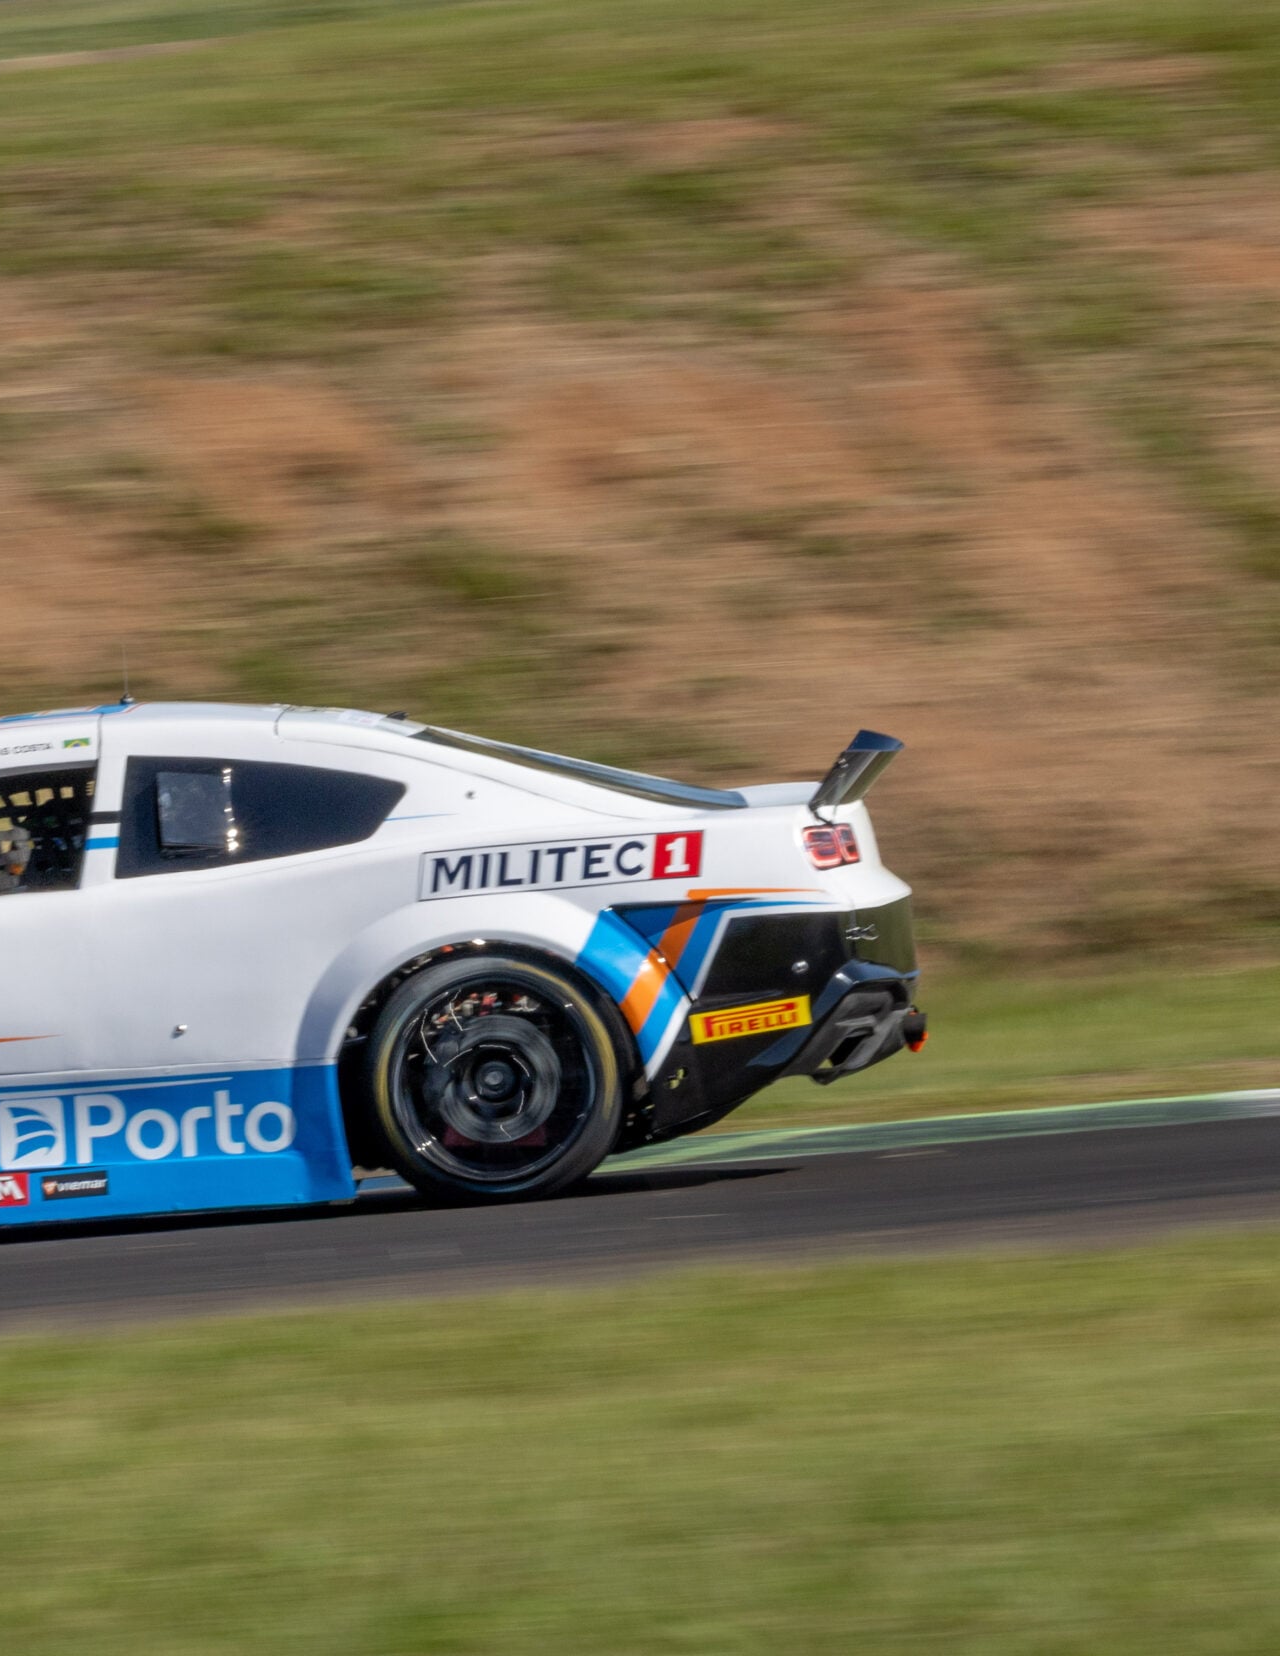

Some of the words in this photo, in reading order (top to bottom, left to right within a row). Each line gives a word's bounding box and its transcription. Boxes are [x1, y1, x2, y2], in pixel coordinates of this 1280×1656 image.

[13, 743, 53, 755] COSTA
[702, 1001, 798, 1039] PIRELLI
[73, 1089, 297, 1164] Porto
